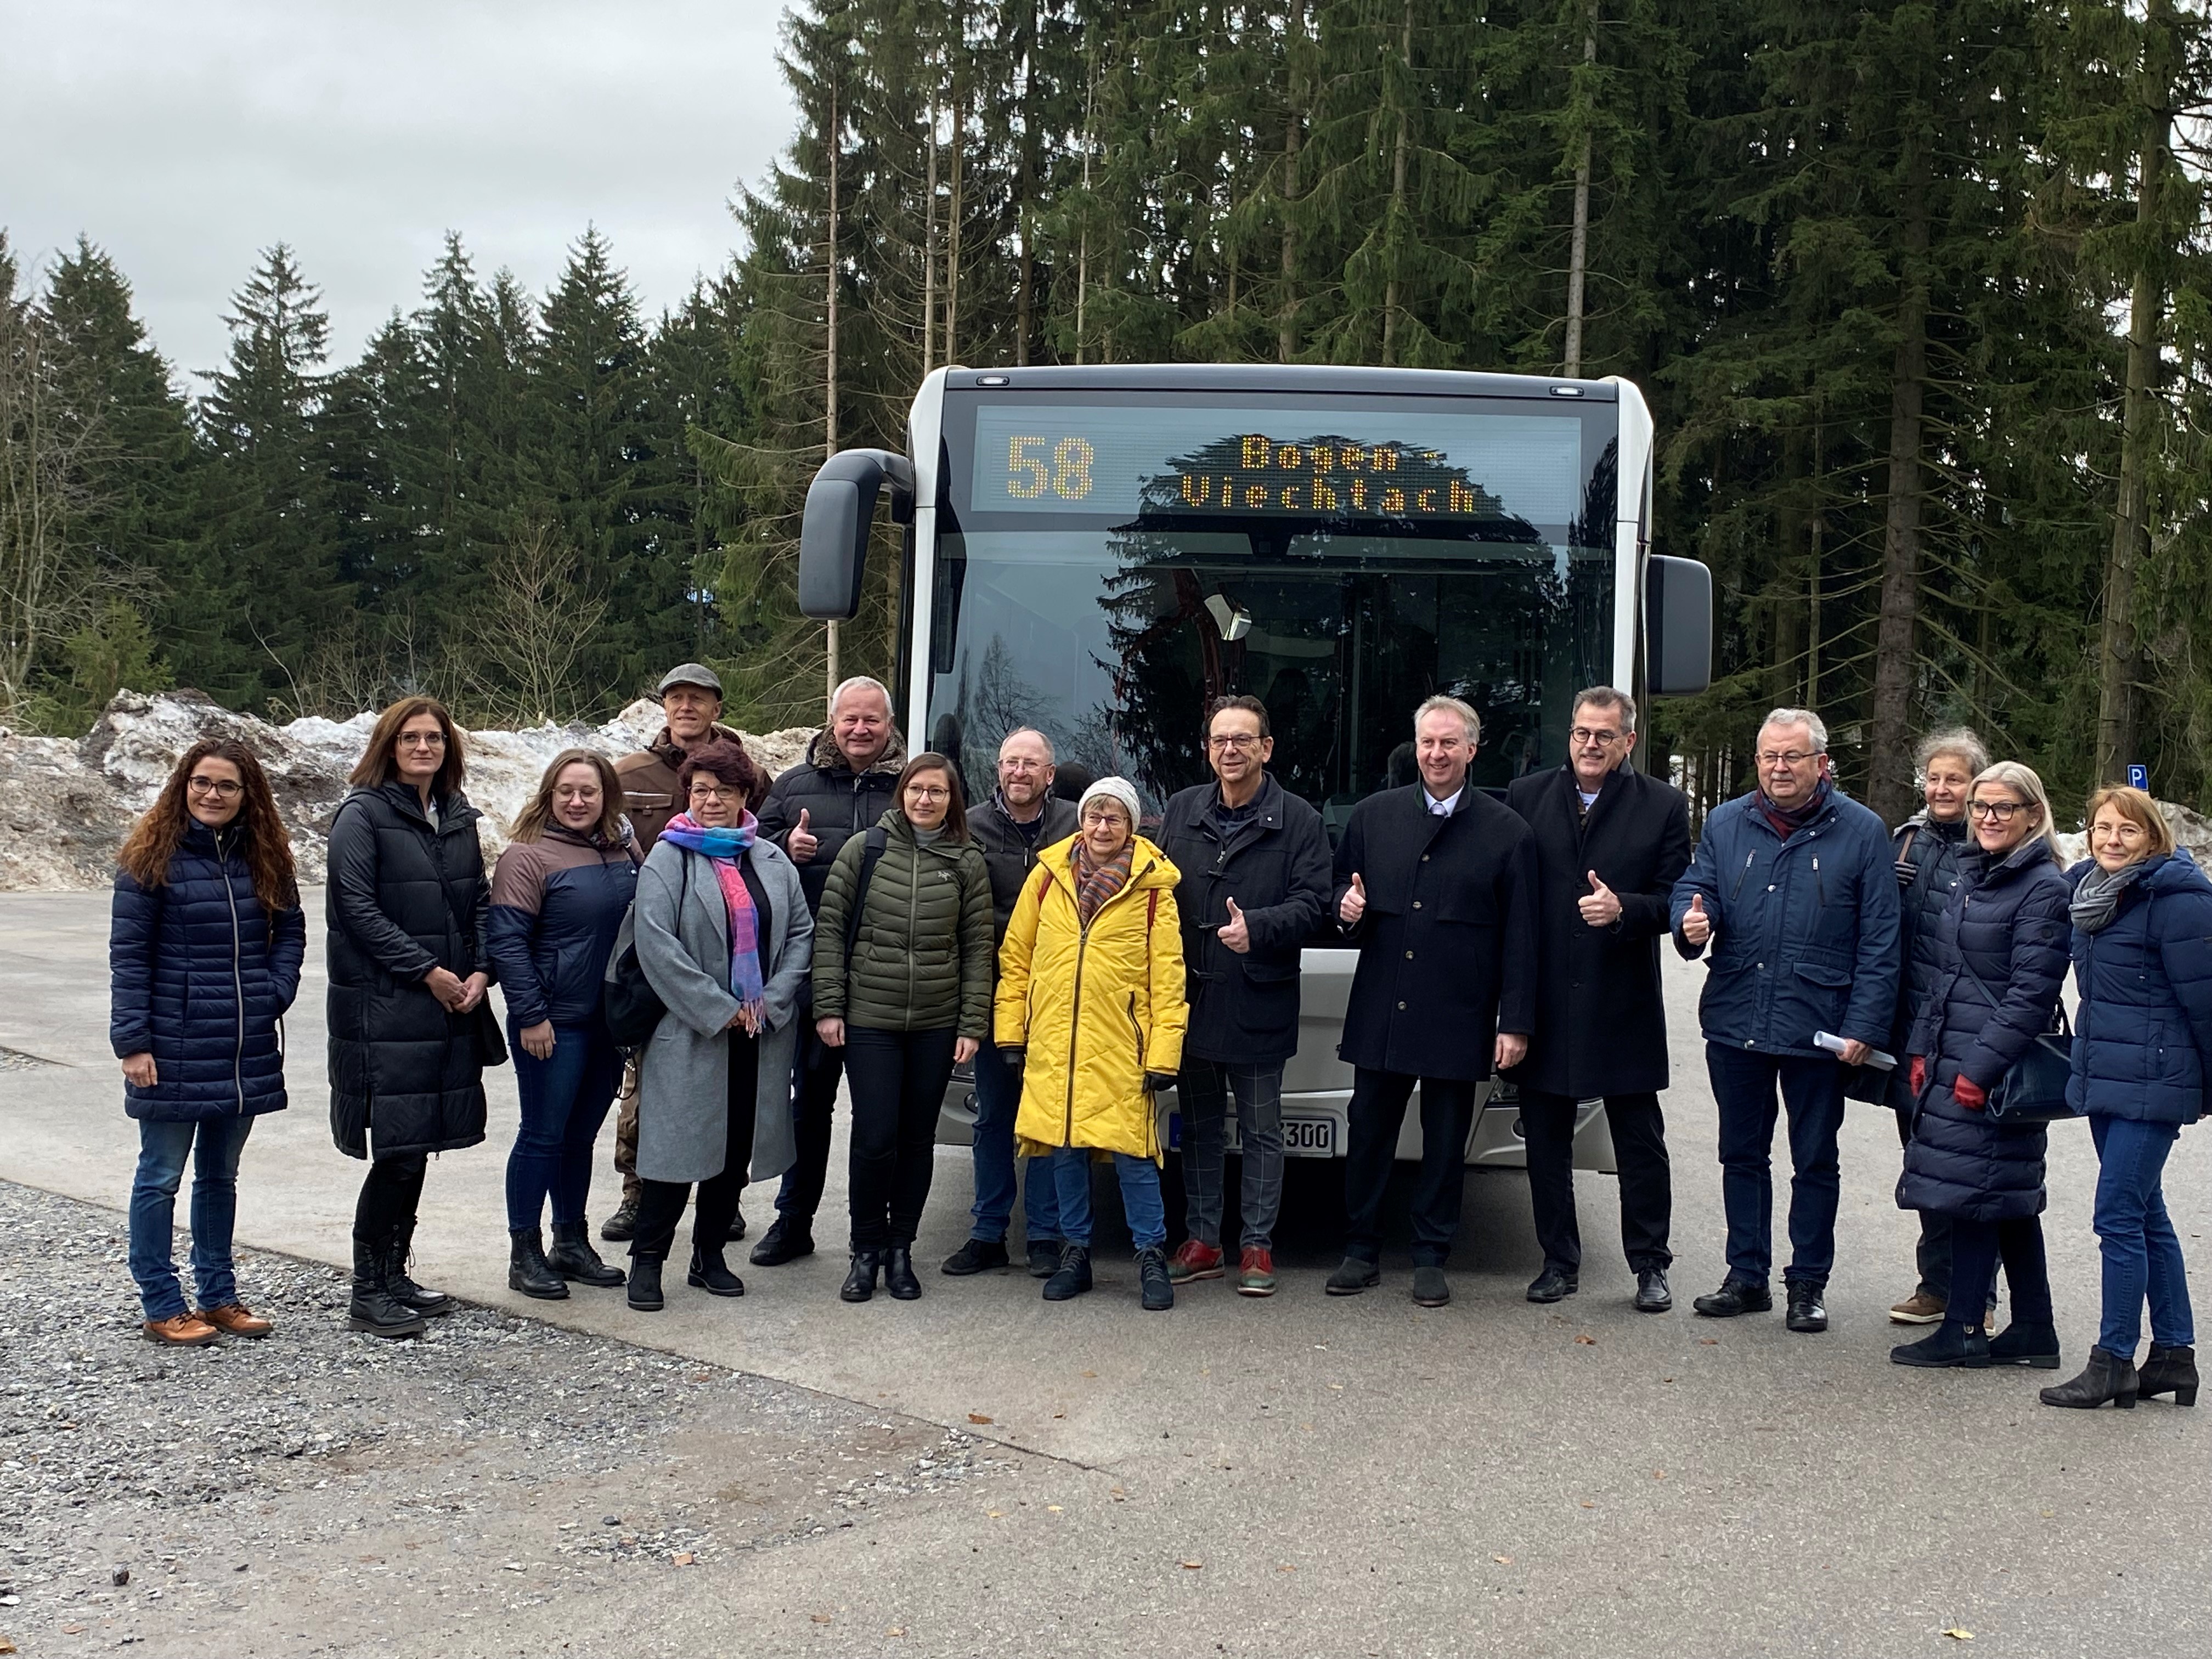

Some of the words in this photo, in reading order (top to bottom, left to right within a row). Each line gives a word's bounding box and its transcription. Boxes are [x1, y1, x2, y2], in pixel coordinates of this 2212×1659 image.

[1007, 436, 1094, 500] 58
[1242, 437, 1397, 474] Bogen
[1182, 475, 1474, 512] Viechtach
[2131, 768, 2142, 787] P
[1280, 1122, 1329, 1148] 300
